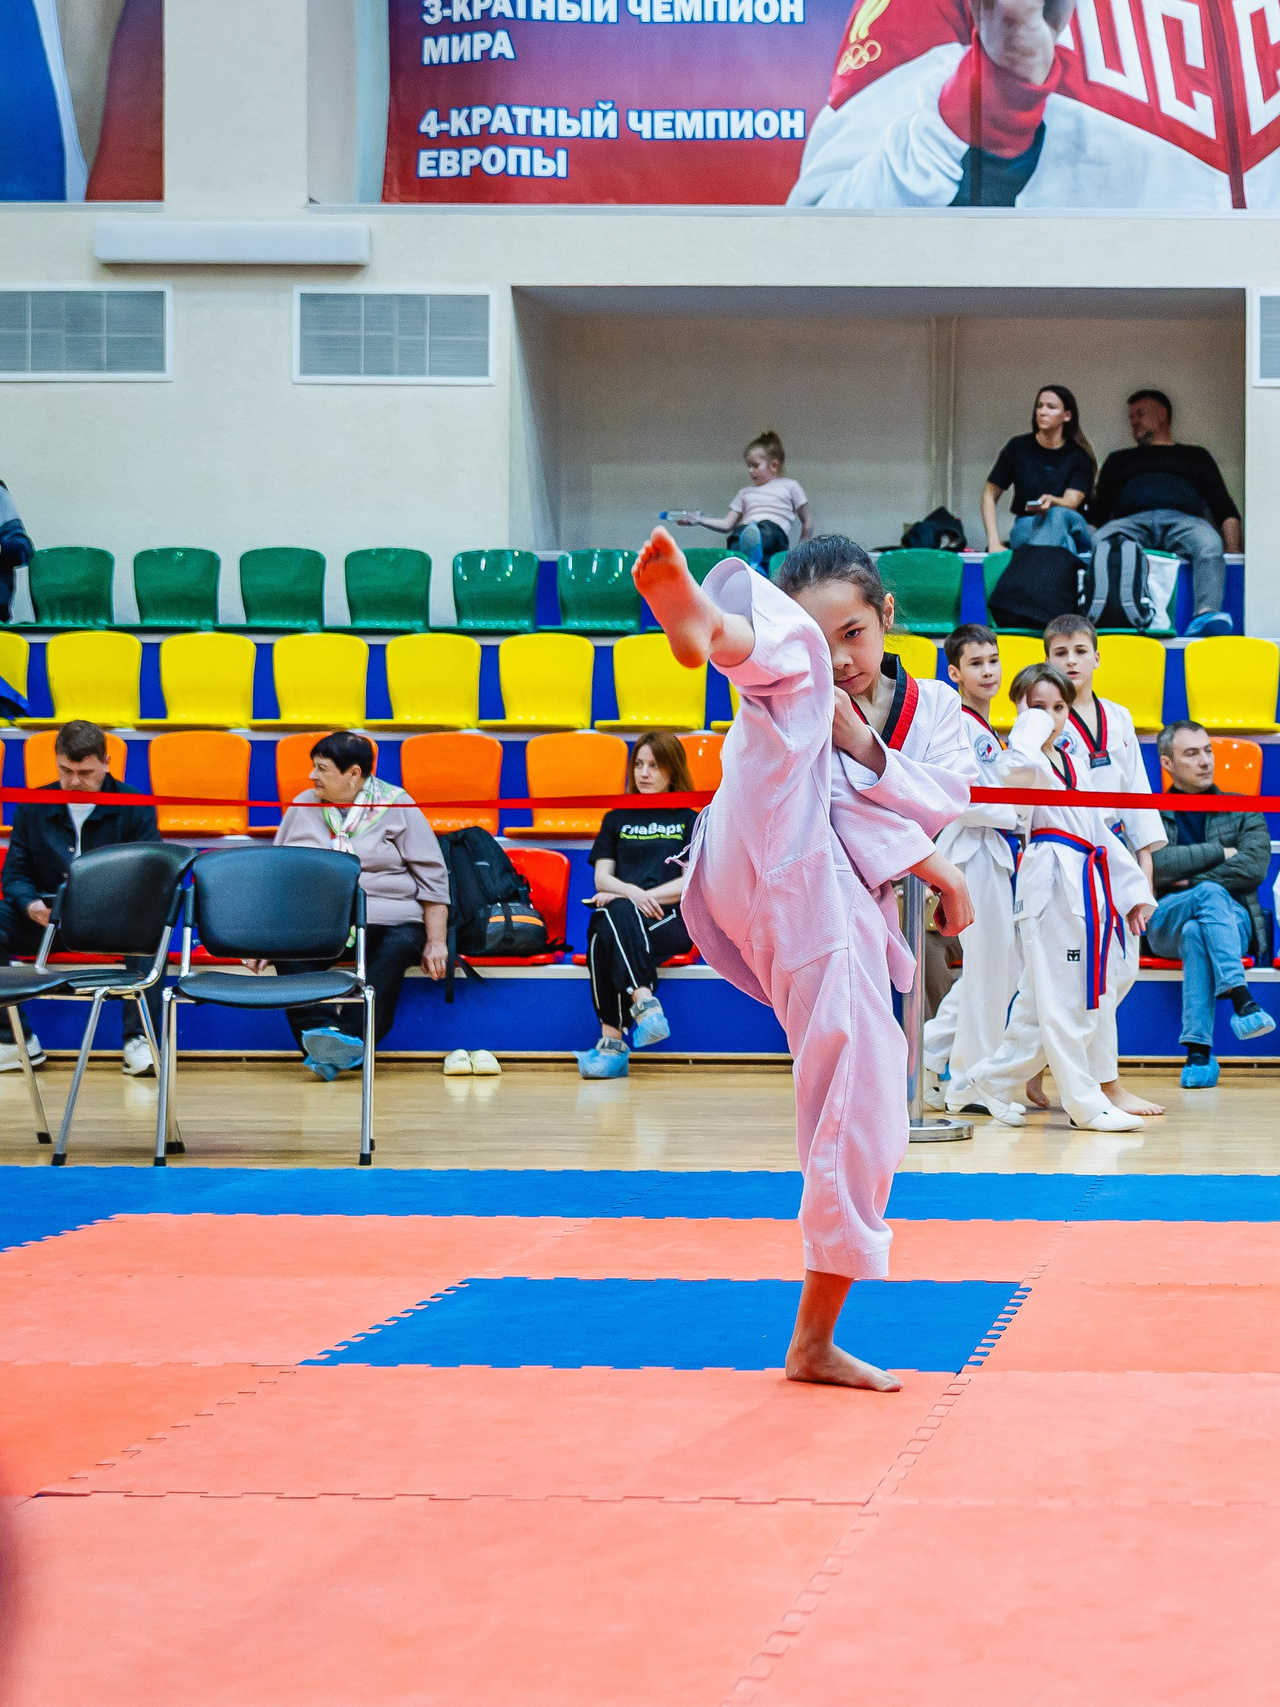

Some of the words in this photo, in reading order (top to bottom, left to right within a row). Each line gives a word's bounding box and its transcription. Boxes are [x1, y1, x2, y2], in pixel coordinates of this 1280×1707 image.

[627, 0, 805, 24] ЧЕМПИОН
[422, 29, 516, 65] МИРА
[419, 101, 618, 139] 4-КРАТНЫЙ
[627, 109, 805, 139] ЧЕМПИОН
[417, 146, 568, 178] ЕВРОПЫ
